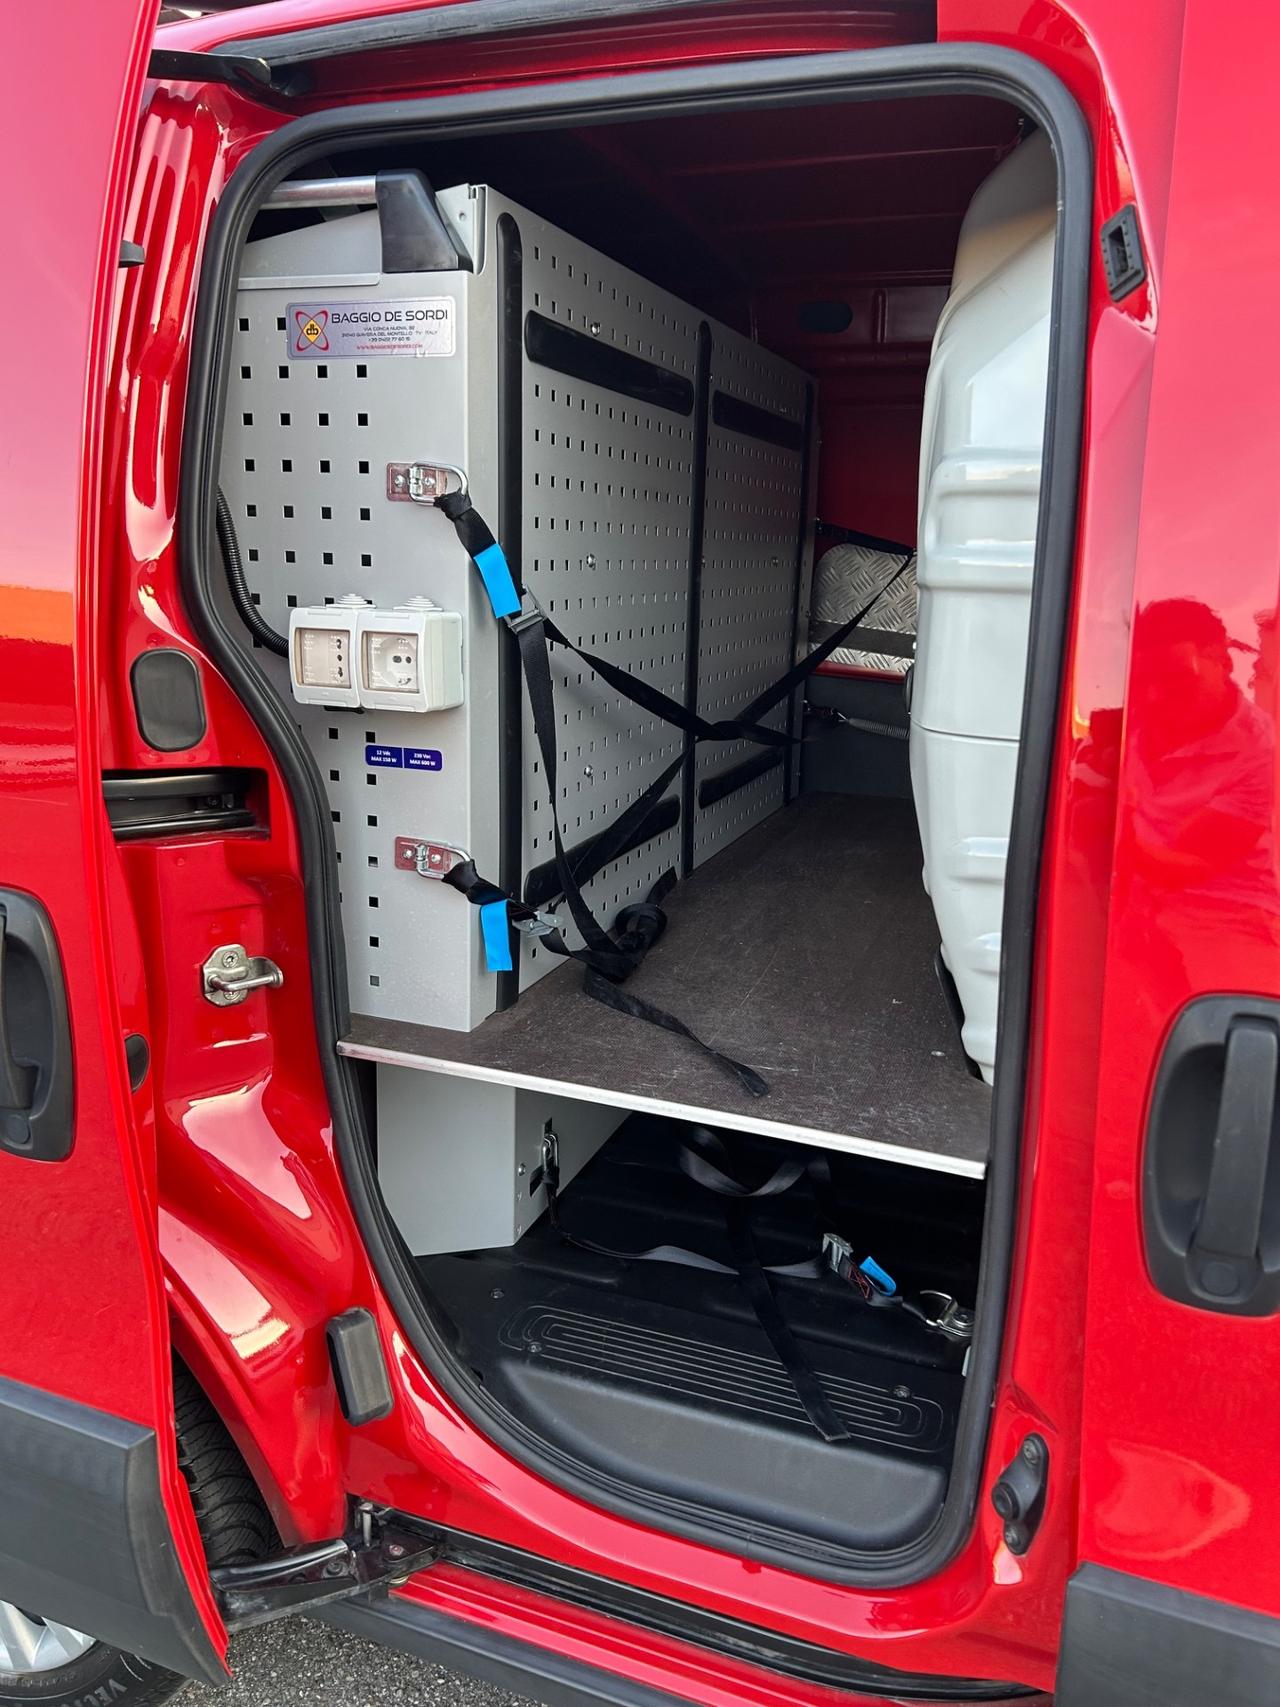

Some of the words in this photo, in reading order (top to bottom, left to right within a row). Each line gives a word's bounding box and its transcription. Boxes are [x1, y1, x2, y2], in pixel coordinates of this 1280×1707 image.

[331, 312, 381, 324] BAGGIO
[385, 310, 402, 322] DE
[405, 309, 448, 321] SORDI
